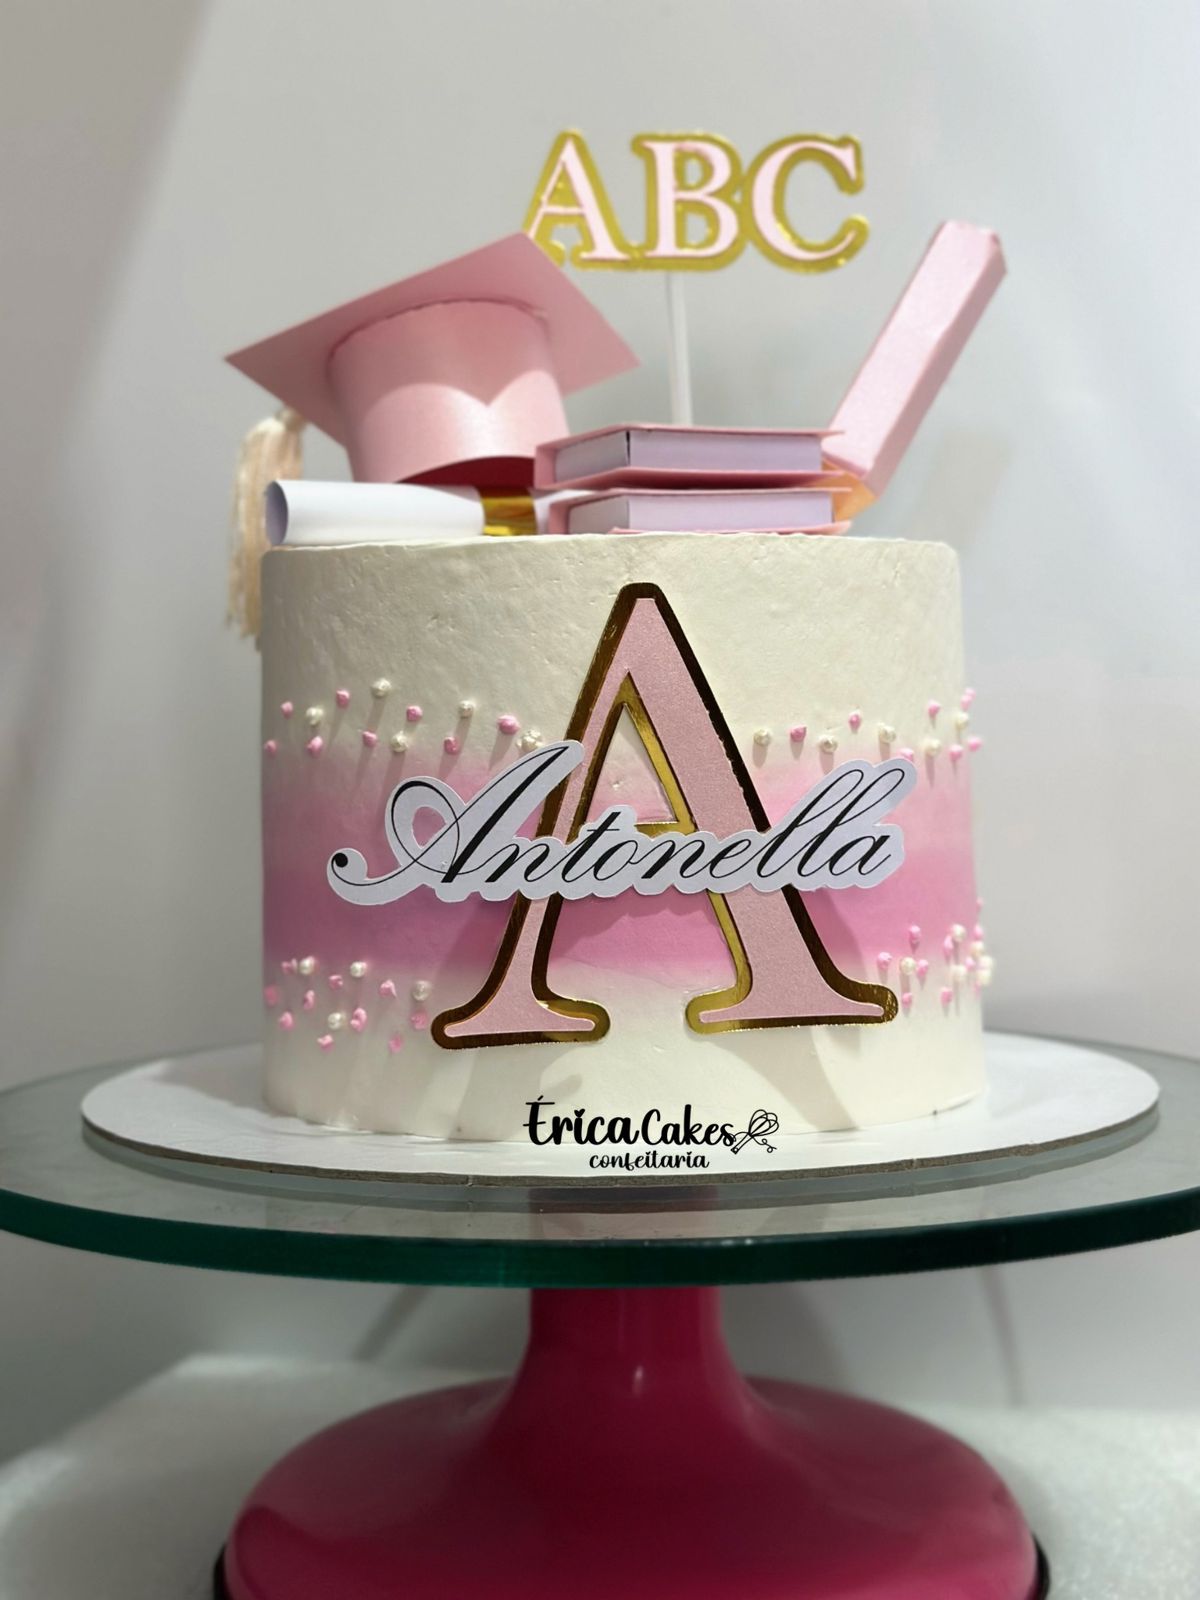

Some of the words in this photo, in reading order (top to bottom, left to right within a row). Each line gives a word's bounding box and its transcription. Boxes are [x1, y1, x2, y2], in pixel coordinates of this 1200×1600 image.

[522, 128, 870, 274] ABC
[331, 746, 906, 887] Antonella
[431, 582, 899, 1049] A
